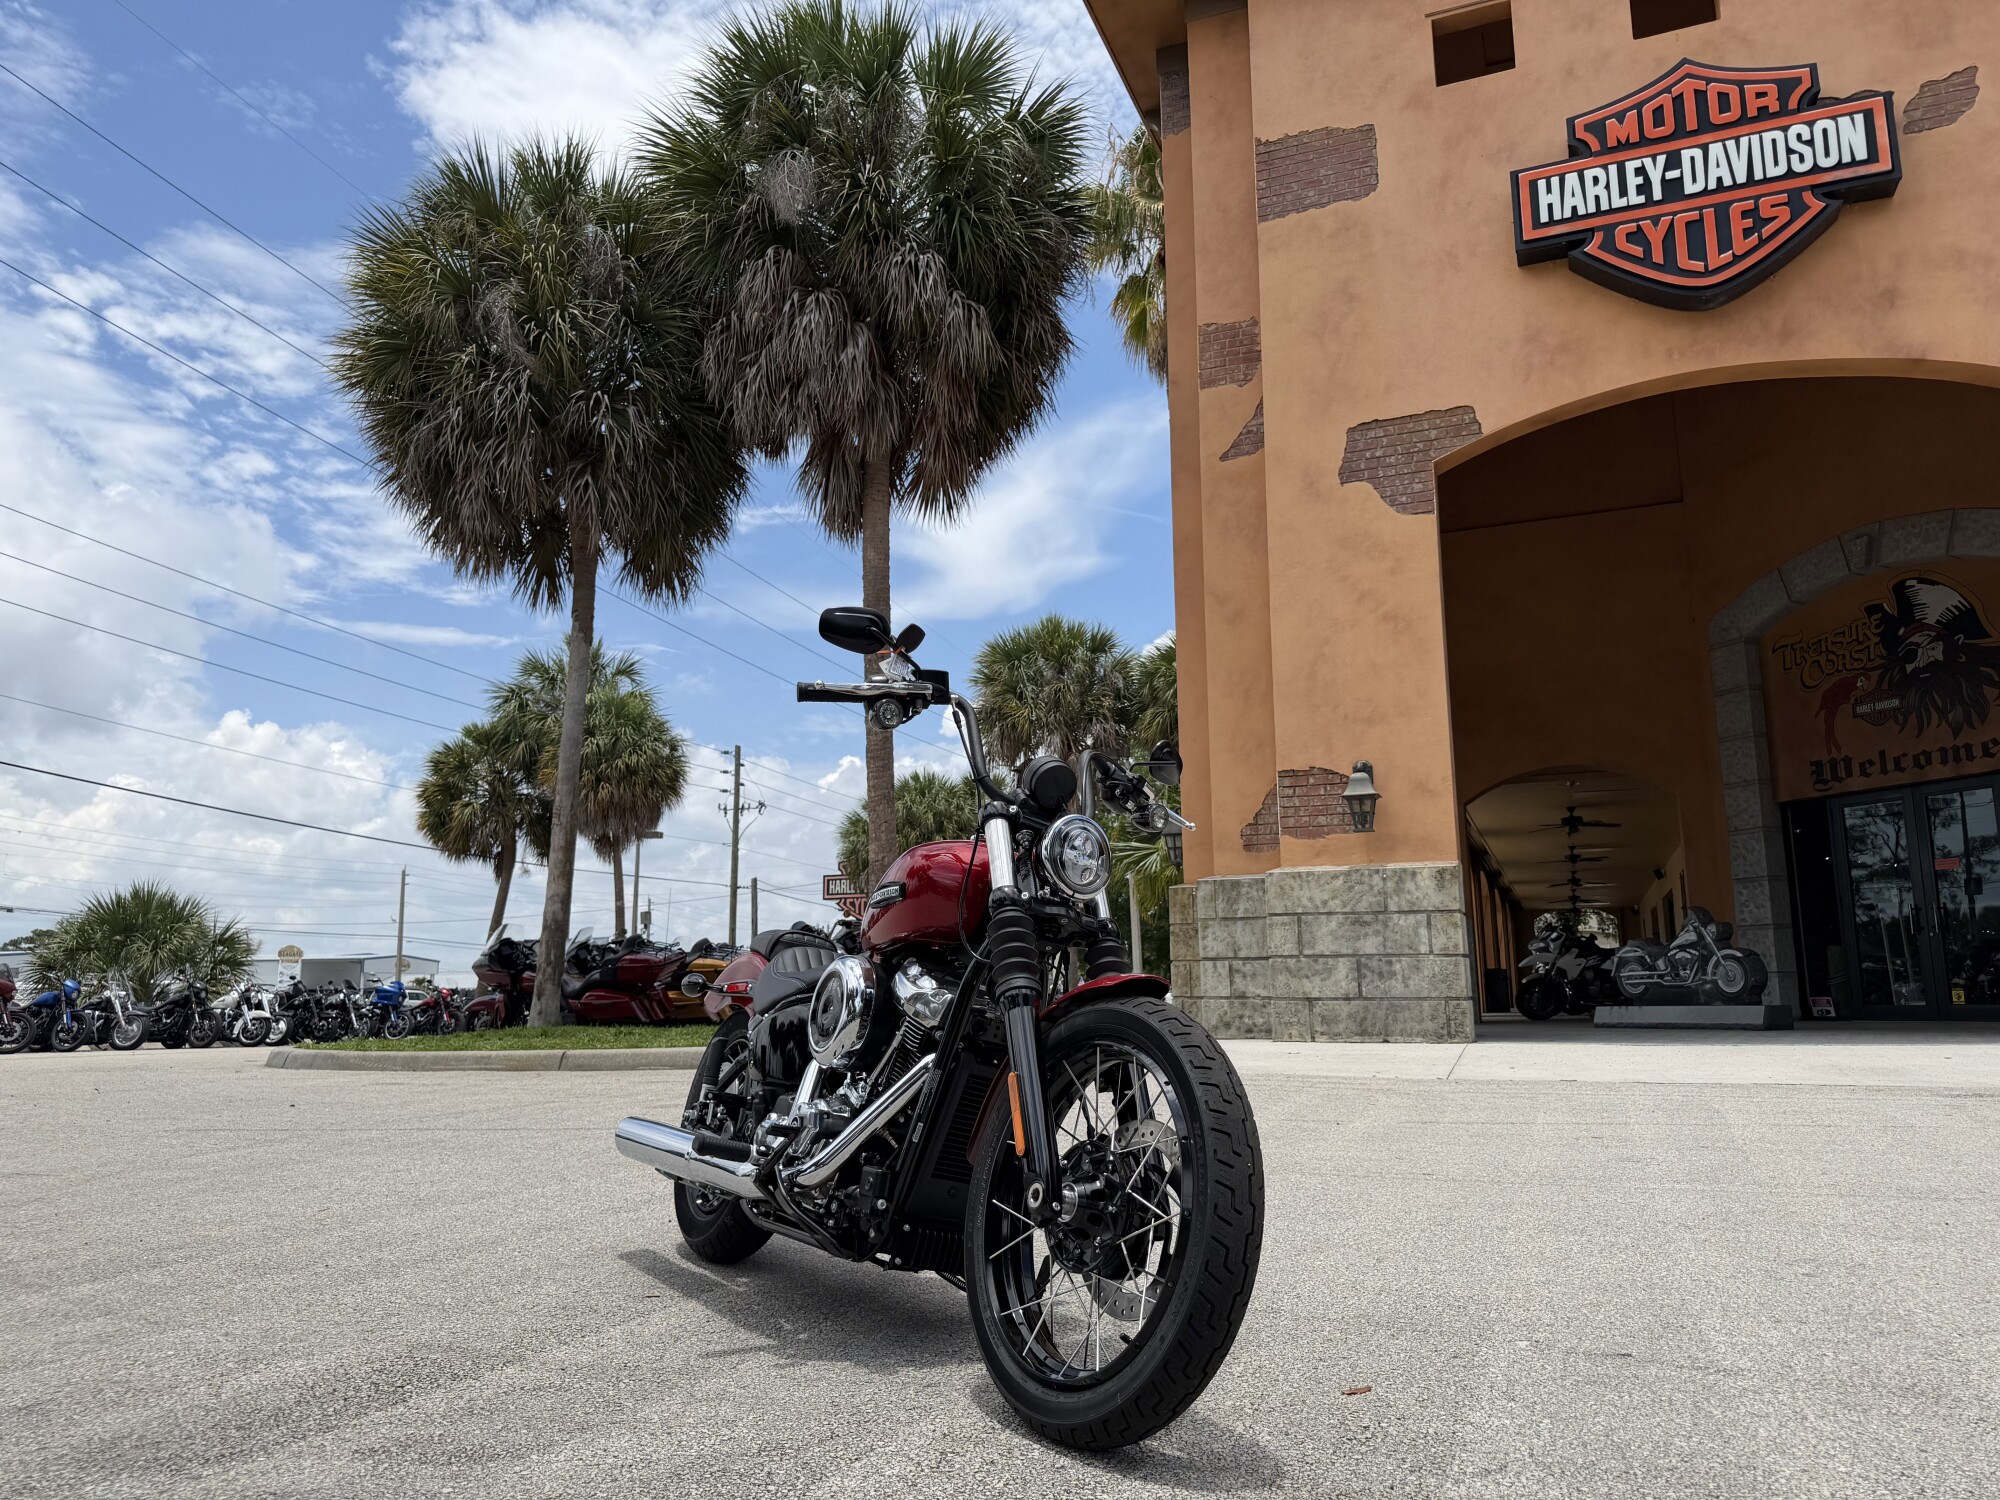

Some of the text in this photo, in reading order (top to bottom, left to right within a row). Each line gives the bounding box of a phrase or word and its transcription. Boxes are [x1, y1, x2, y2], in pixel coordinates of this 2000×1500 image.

[1605, 78, 1779, 148] MOTOR
[1536, 113, 1869, 224] HARLEY-DAVIDSON
[1614, 193, 1791, 272] CYCLES
[1809, 736, 2000, 792] Welcome
